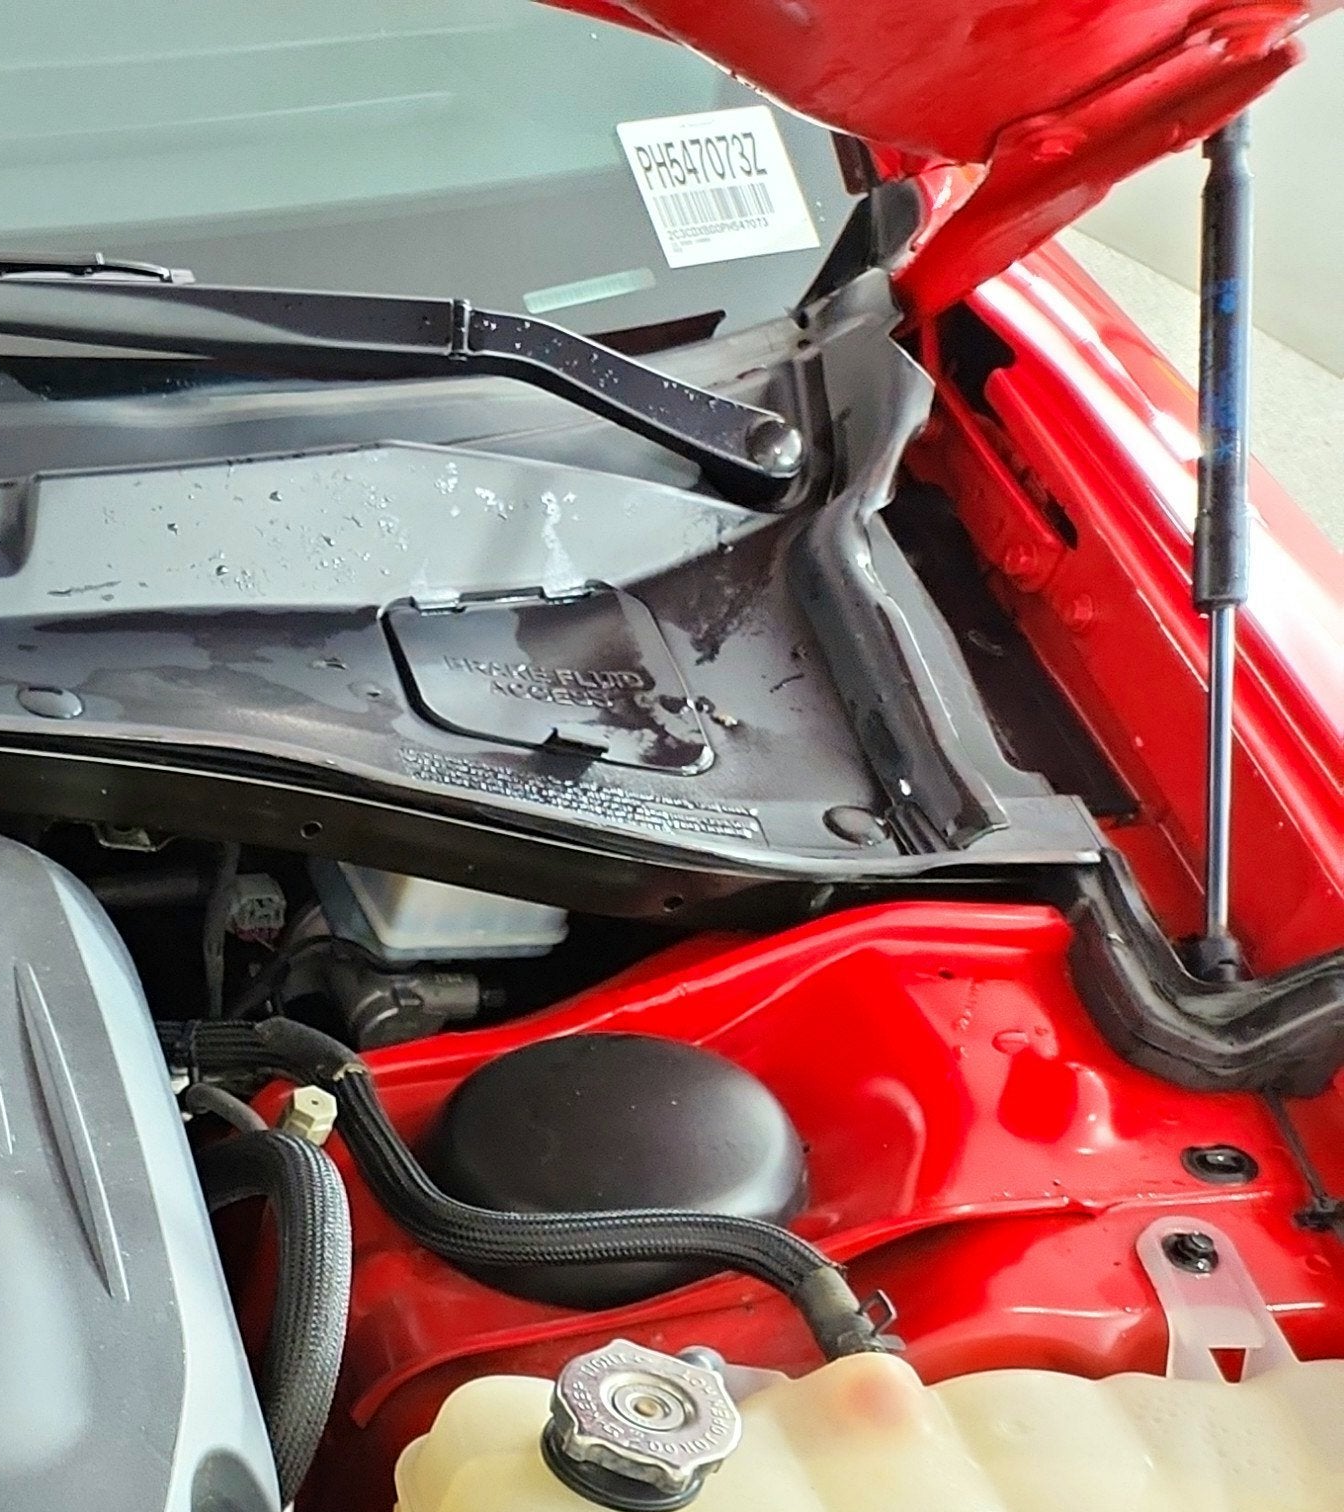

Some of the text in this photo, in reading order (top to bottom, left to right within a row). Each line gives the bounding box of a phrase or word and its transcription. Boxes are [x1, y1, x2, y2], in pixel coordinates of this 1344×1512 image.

[633, 131, 768, 190] PH547073Z
[442, 655, 645, 690] BRAKE FLUID
[490, 680, 613, 708] ACCESS
